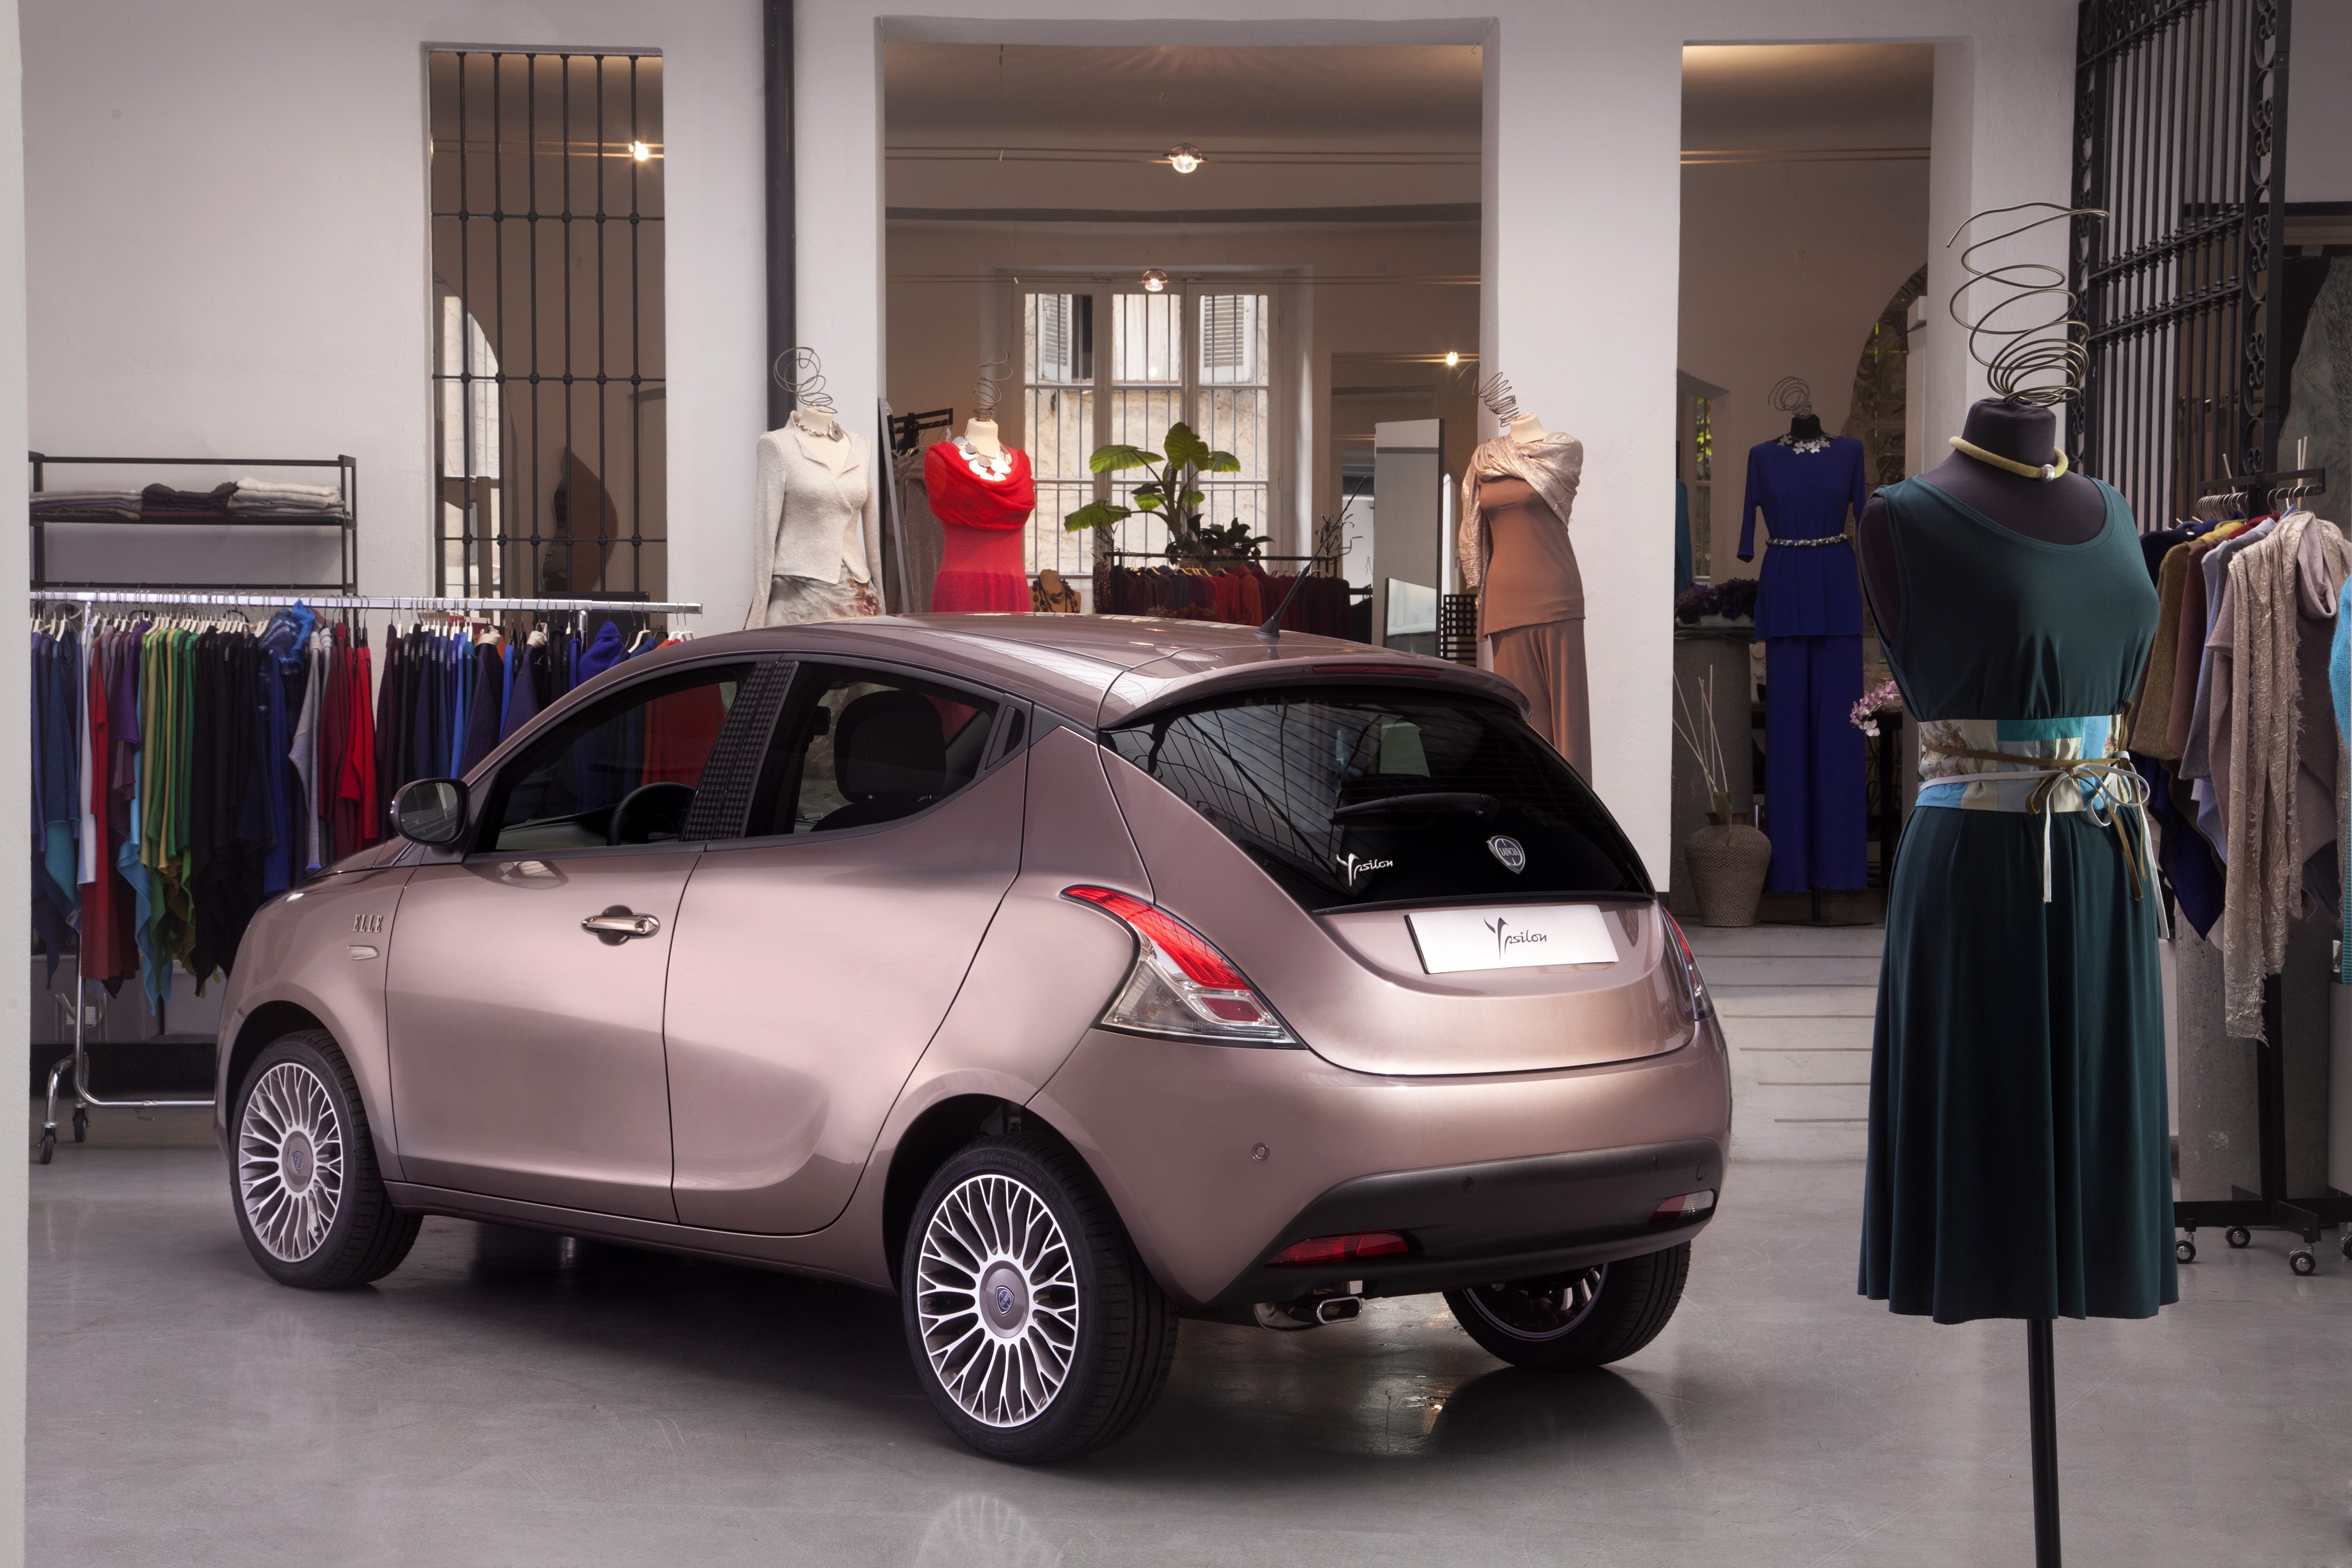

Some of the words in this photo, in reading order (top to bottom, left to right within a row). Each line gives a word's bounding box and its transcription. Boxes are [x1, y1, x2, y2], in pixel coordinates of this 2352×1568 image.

[1498, 847, 1521, 856] LANCIA
[1336, 853, 1393, 887] Ypsilon
[353, 914, 383, 933] ELLE
[1483, 916, 1547, 962] Ypsilon
